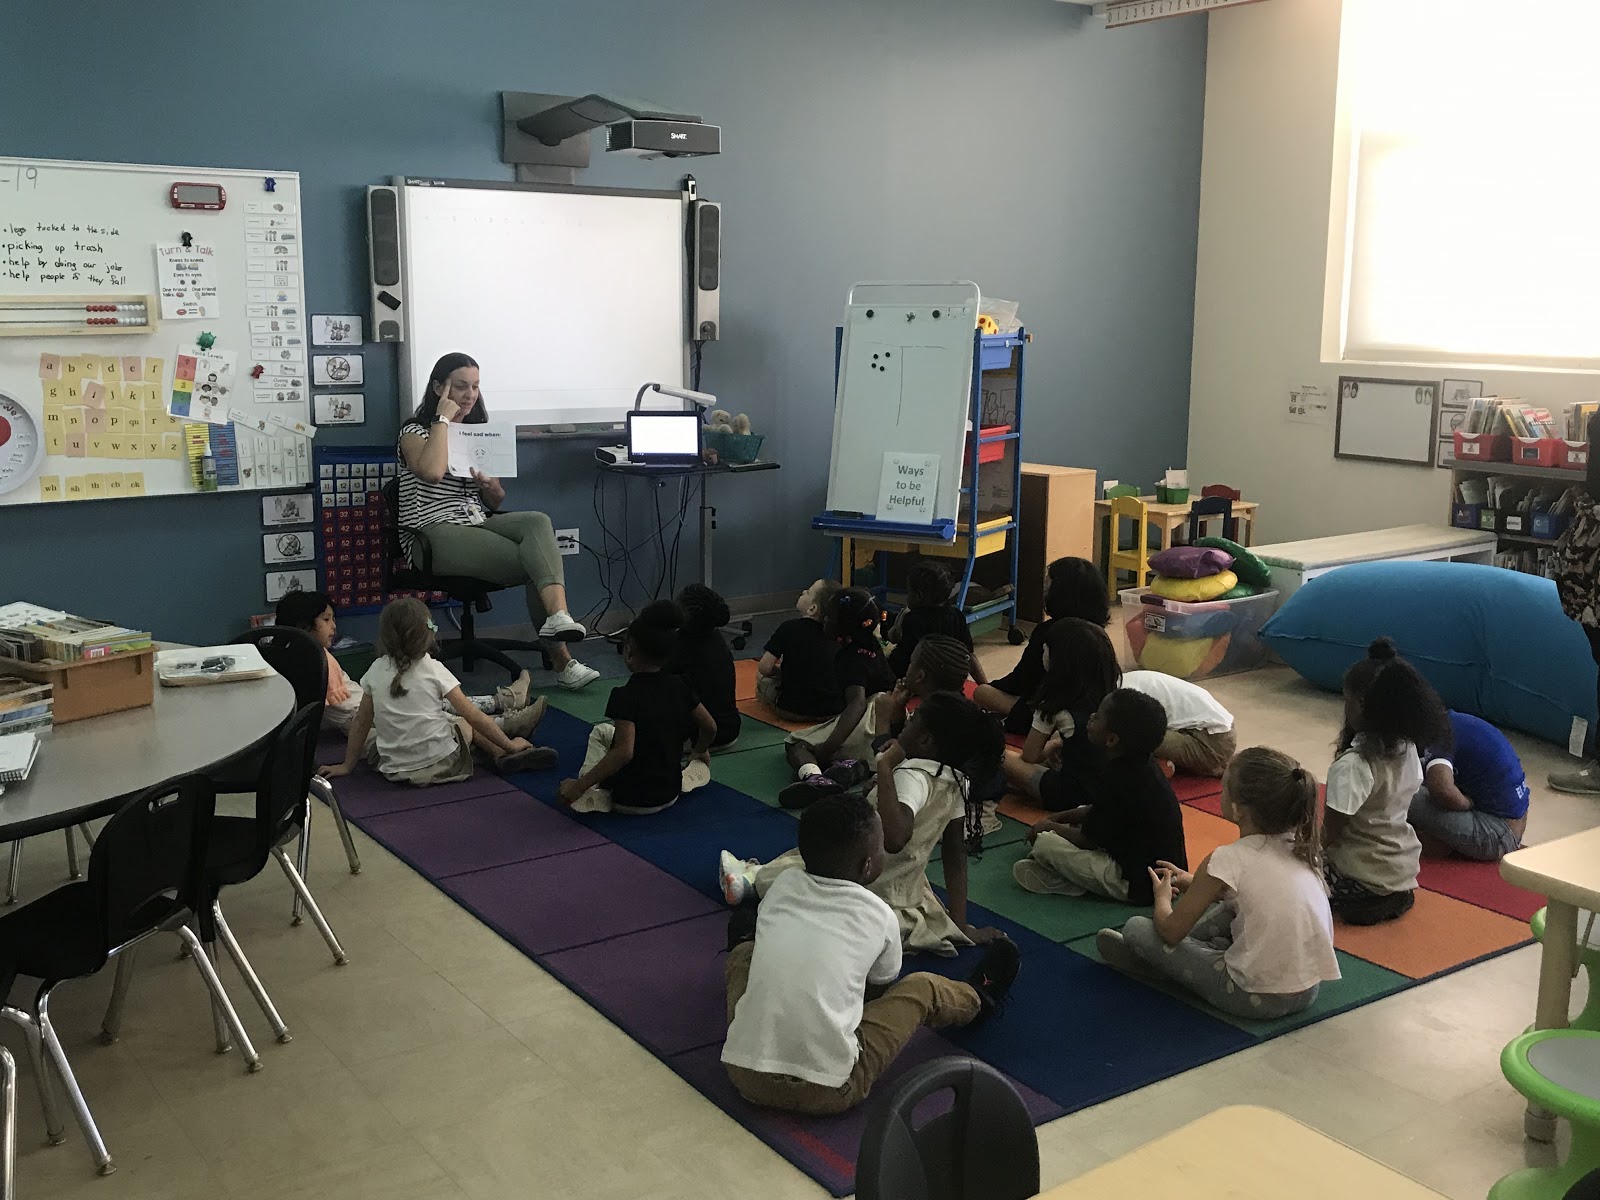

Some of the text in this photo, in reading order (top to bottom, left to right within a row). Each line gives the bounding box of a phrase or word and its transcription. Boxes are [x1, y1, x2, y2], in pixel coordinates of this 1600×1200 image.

[86, 224, 98, 233] the
[7, 240, 103, 255] picking up trash
[159, 246, 181, 256] Turn
[195, 245, 214, 256] Talk
[9, 256, 30, 269] help
[38, 257, 47, 268] by
[54, 257, 77, 271] doing
[9, 269, 30, 282] help
[40, 272, 65, 283] people
[87, 274, 104, 286] they
[110, 274, 126, 285] fall
[68, 364, 75, 372] b
[108, 364, 115, 372] d
[50, 389, 57, 397] g
[69, 388, 76, 396] h
[129, 391, 136, 400] k
[111, 417, 118, 426] p
[150, 444, 157, 452] y
[898, 465, 924, 477] Ways
[896, 480, 921, 490] to be
[889, 495, 925, 507] Helpful
